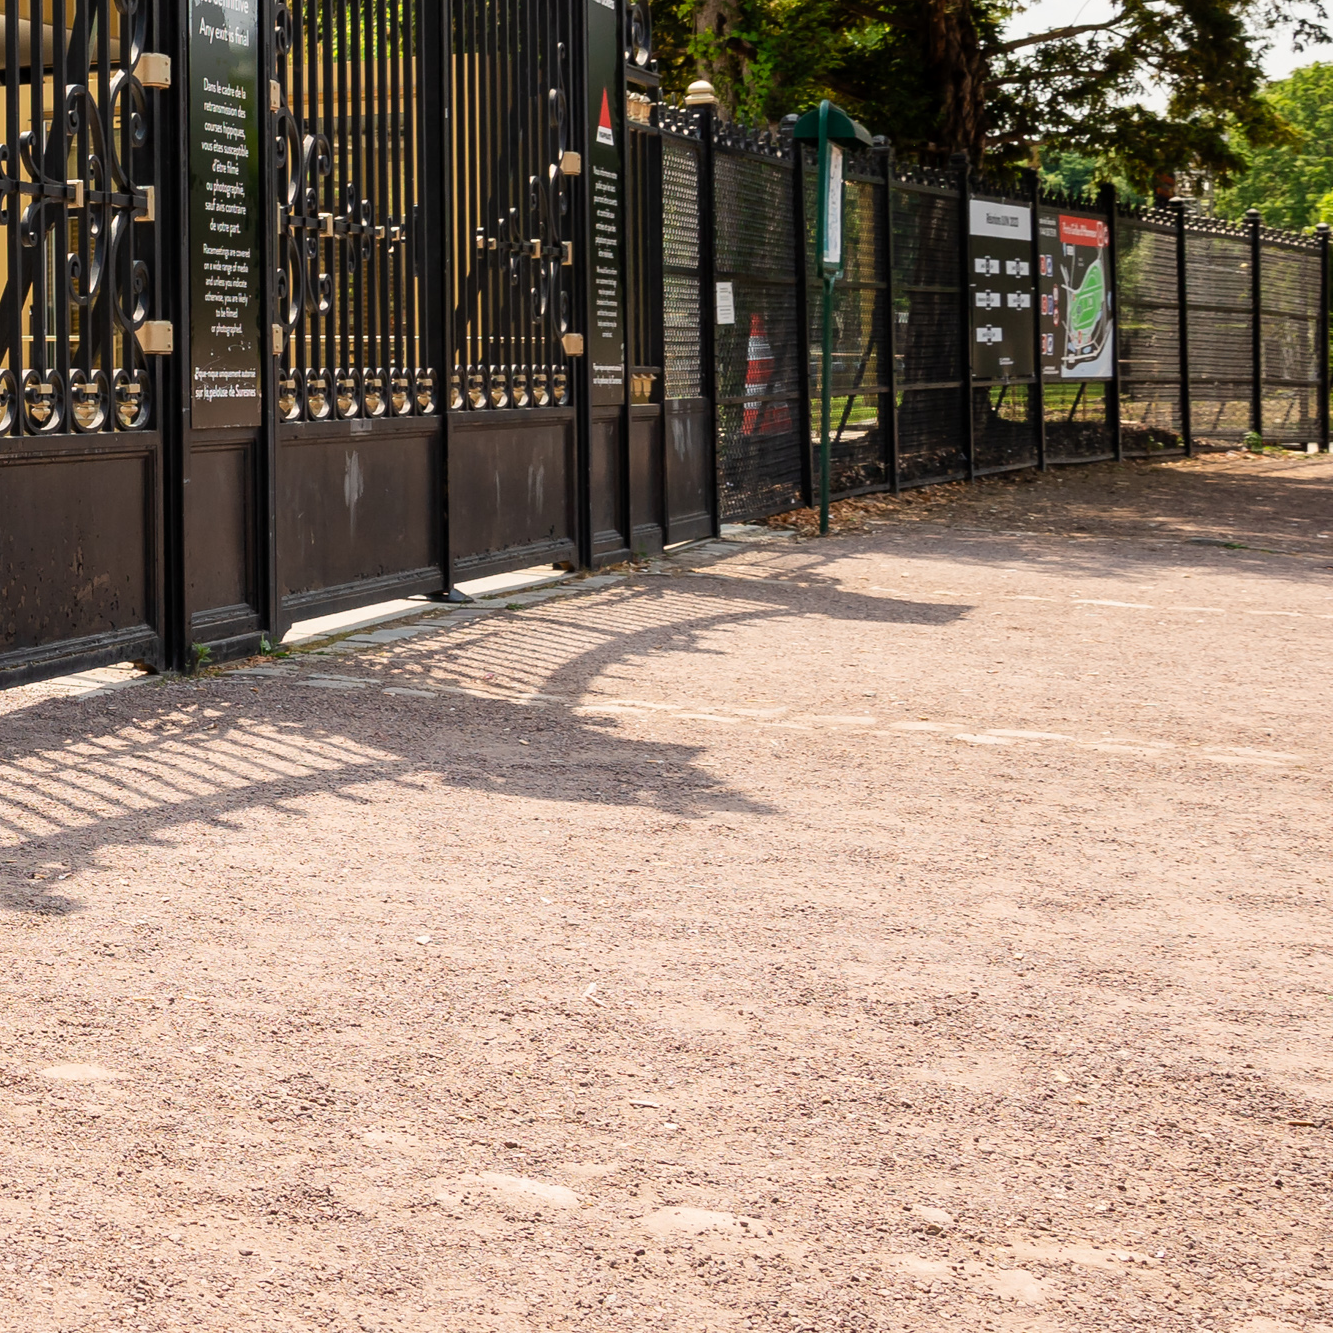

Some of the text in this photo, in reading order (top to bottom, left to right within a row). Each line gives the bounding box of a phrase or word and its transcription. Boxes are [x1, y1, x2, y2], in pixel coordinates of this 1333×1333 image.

[199, 17, 250, 47] Any exit is final
[203, 77, 247, 99] Dans le cadre de la
[238, 105, 246, 118] des
[204, 122, 222, 133] courses
[201, 142, 213, 152] vous
